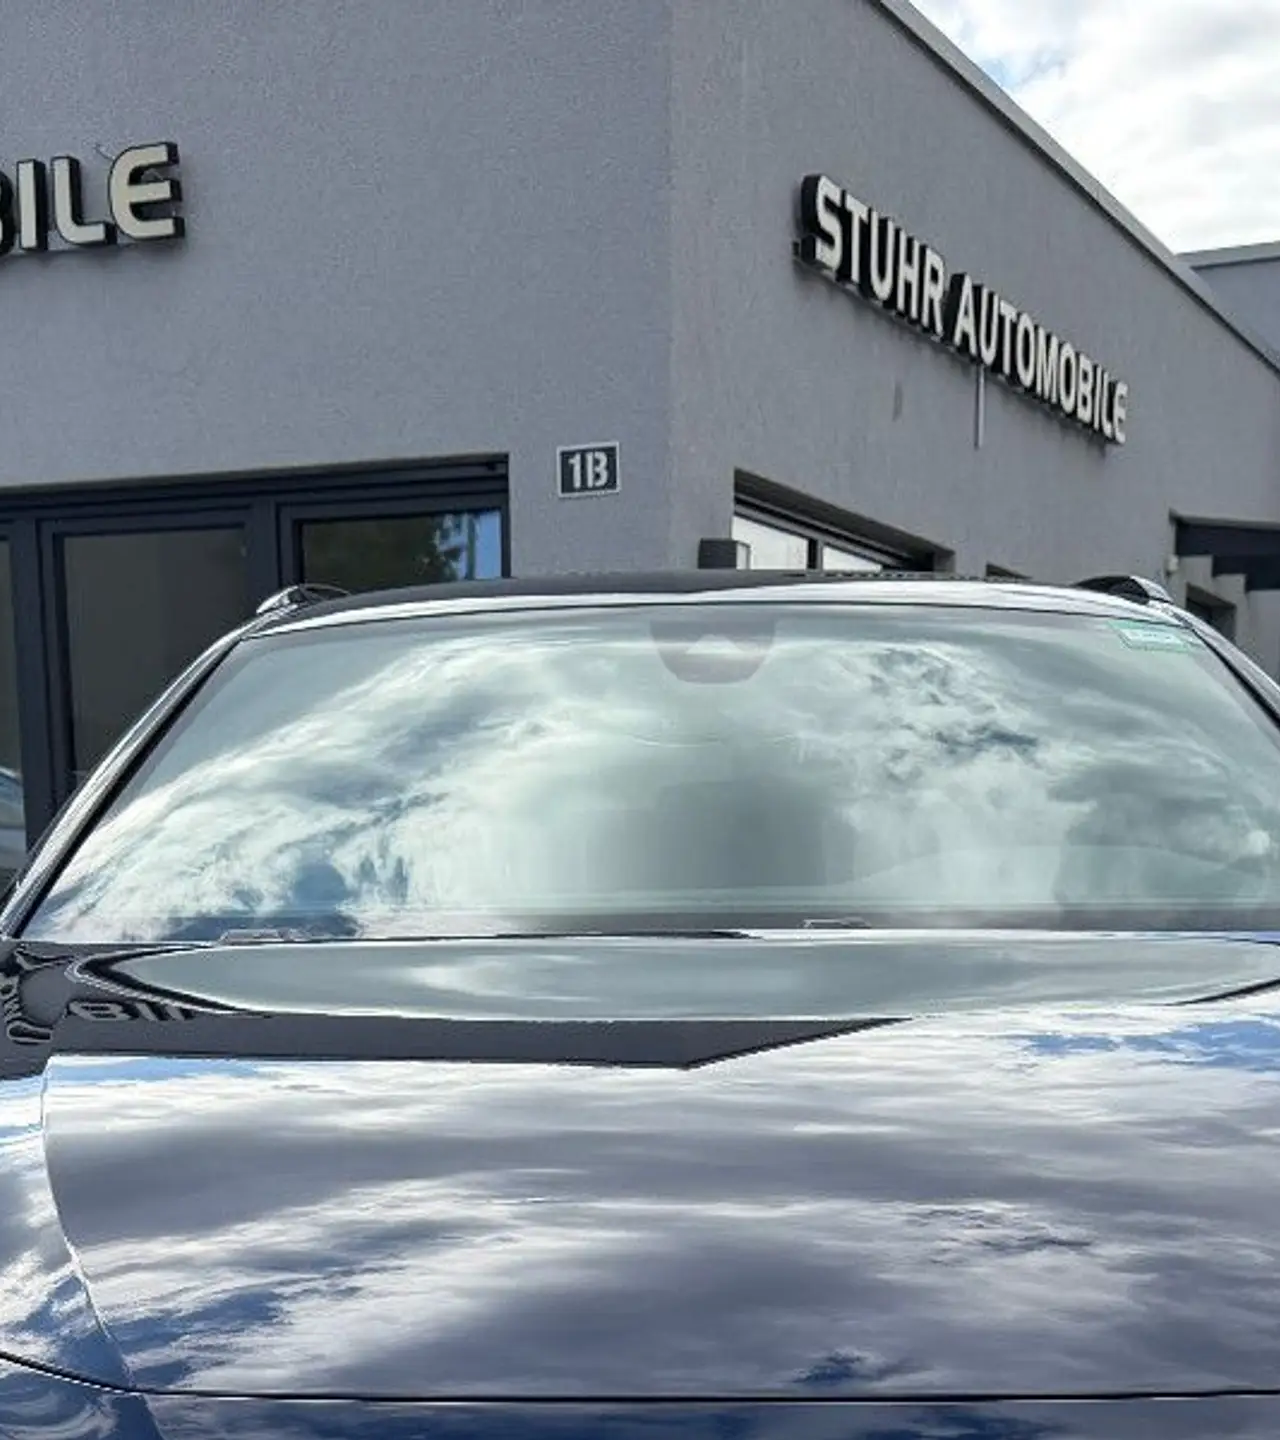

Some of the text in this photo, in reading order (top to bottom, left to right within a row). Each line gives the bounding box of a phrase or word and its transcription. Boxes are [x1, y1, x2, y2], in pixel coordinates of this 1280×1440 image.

[804, 173, 1129, 445] STUHR AUTOMOBILE
[568, 450, 608, 489] 1B
